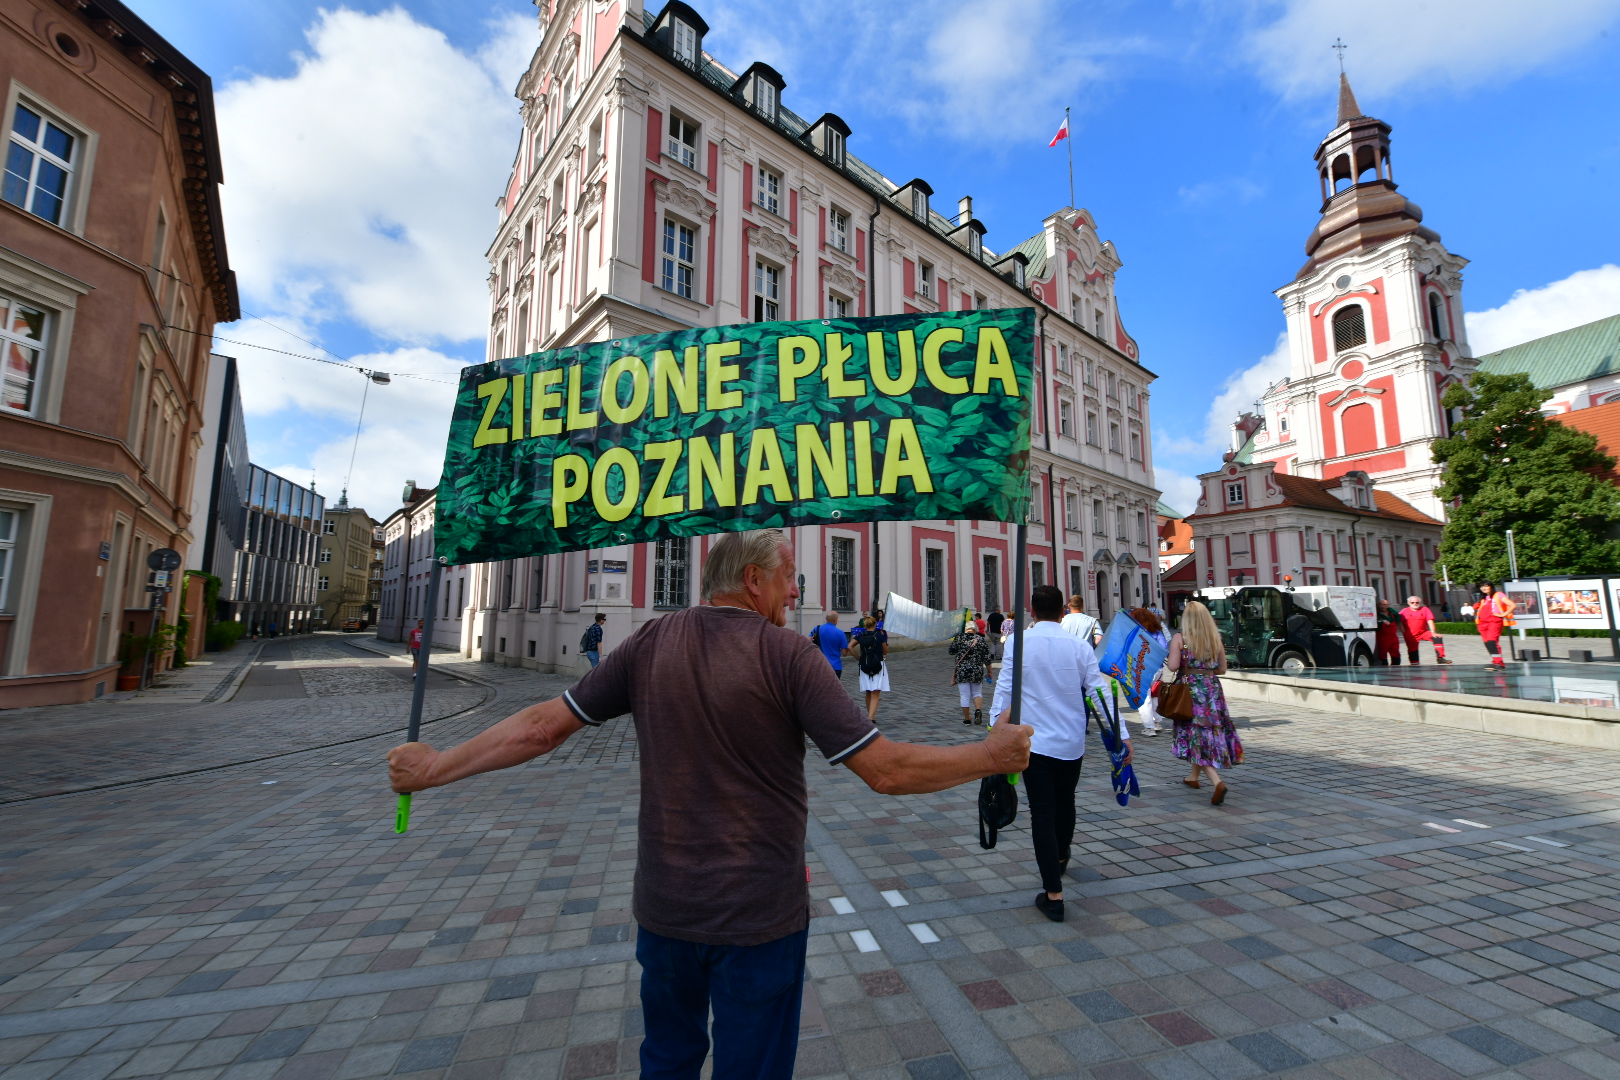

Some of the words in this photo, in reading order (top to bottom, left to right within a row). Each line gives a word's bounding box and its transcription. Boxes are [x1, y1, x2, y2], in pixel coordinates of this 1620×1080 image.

[474, 340, 743, 448] ZIELONE
[779, 327, 1020, 402] PŁUCA
[552, 418, 934, 529] POZNANIA
